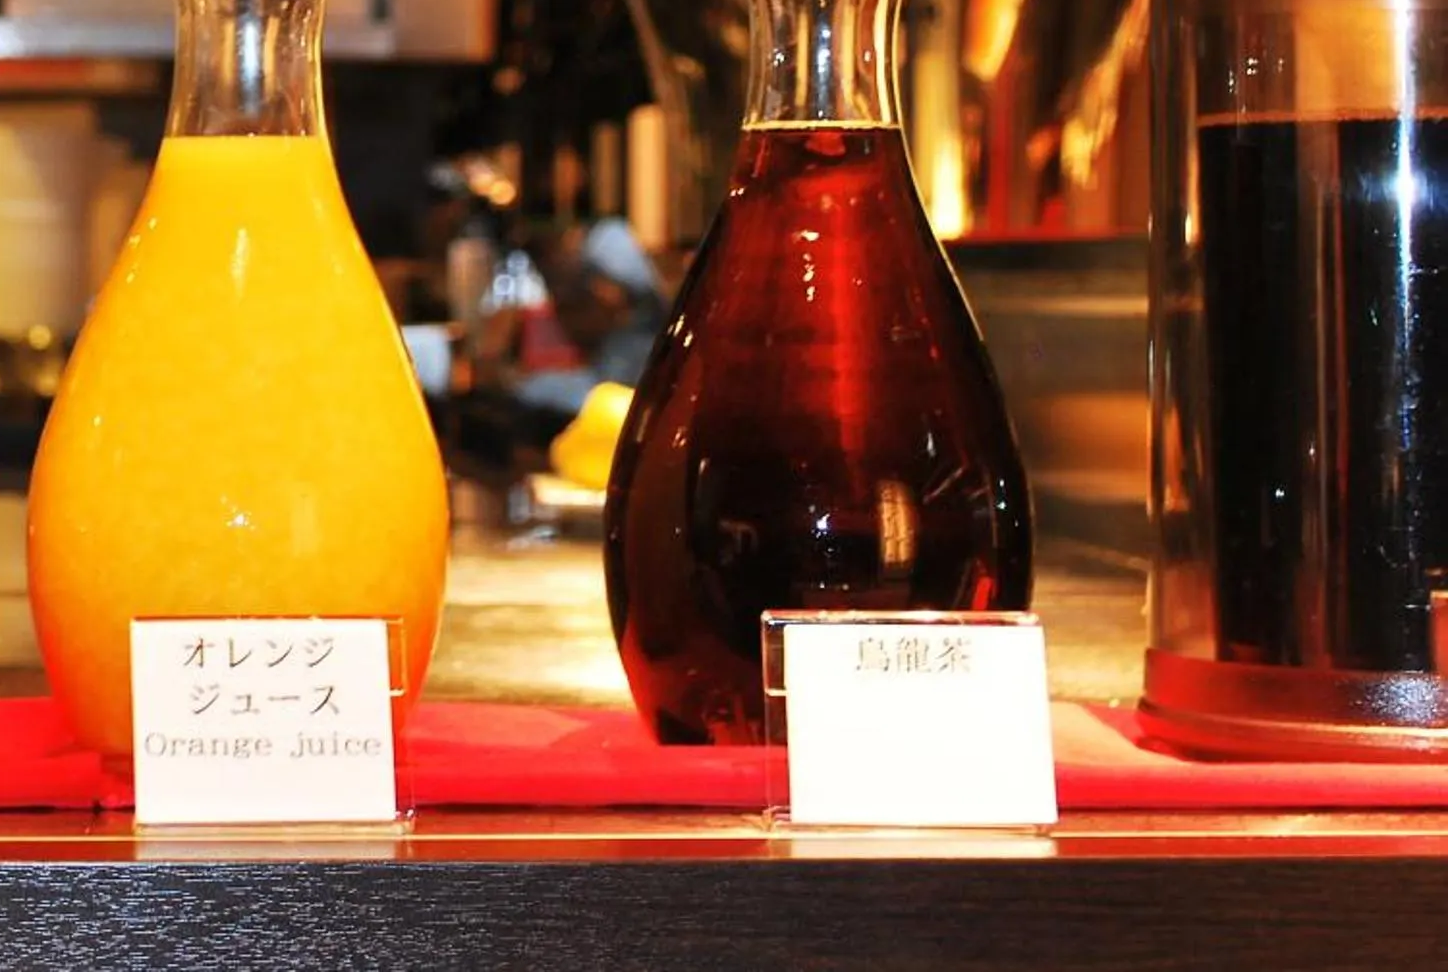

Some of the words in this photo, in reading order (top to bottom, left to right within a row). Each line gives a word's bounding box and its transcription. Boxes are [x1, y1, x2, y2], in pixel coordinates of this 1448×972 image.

[182, 636, 335, 669] オレンジ
[189, 683, 340, 716] ジュース
[143, 730, 274, 759] Orange
[289, 730, 383, 759] juice
